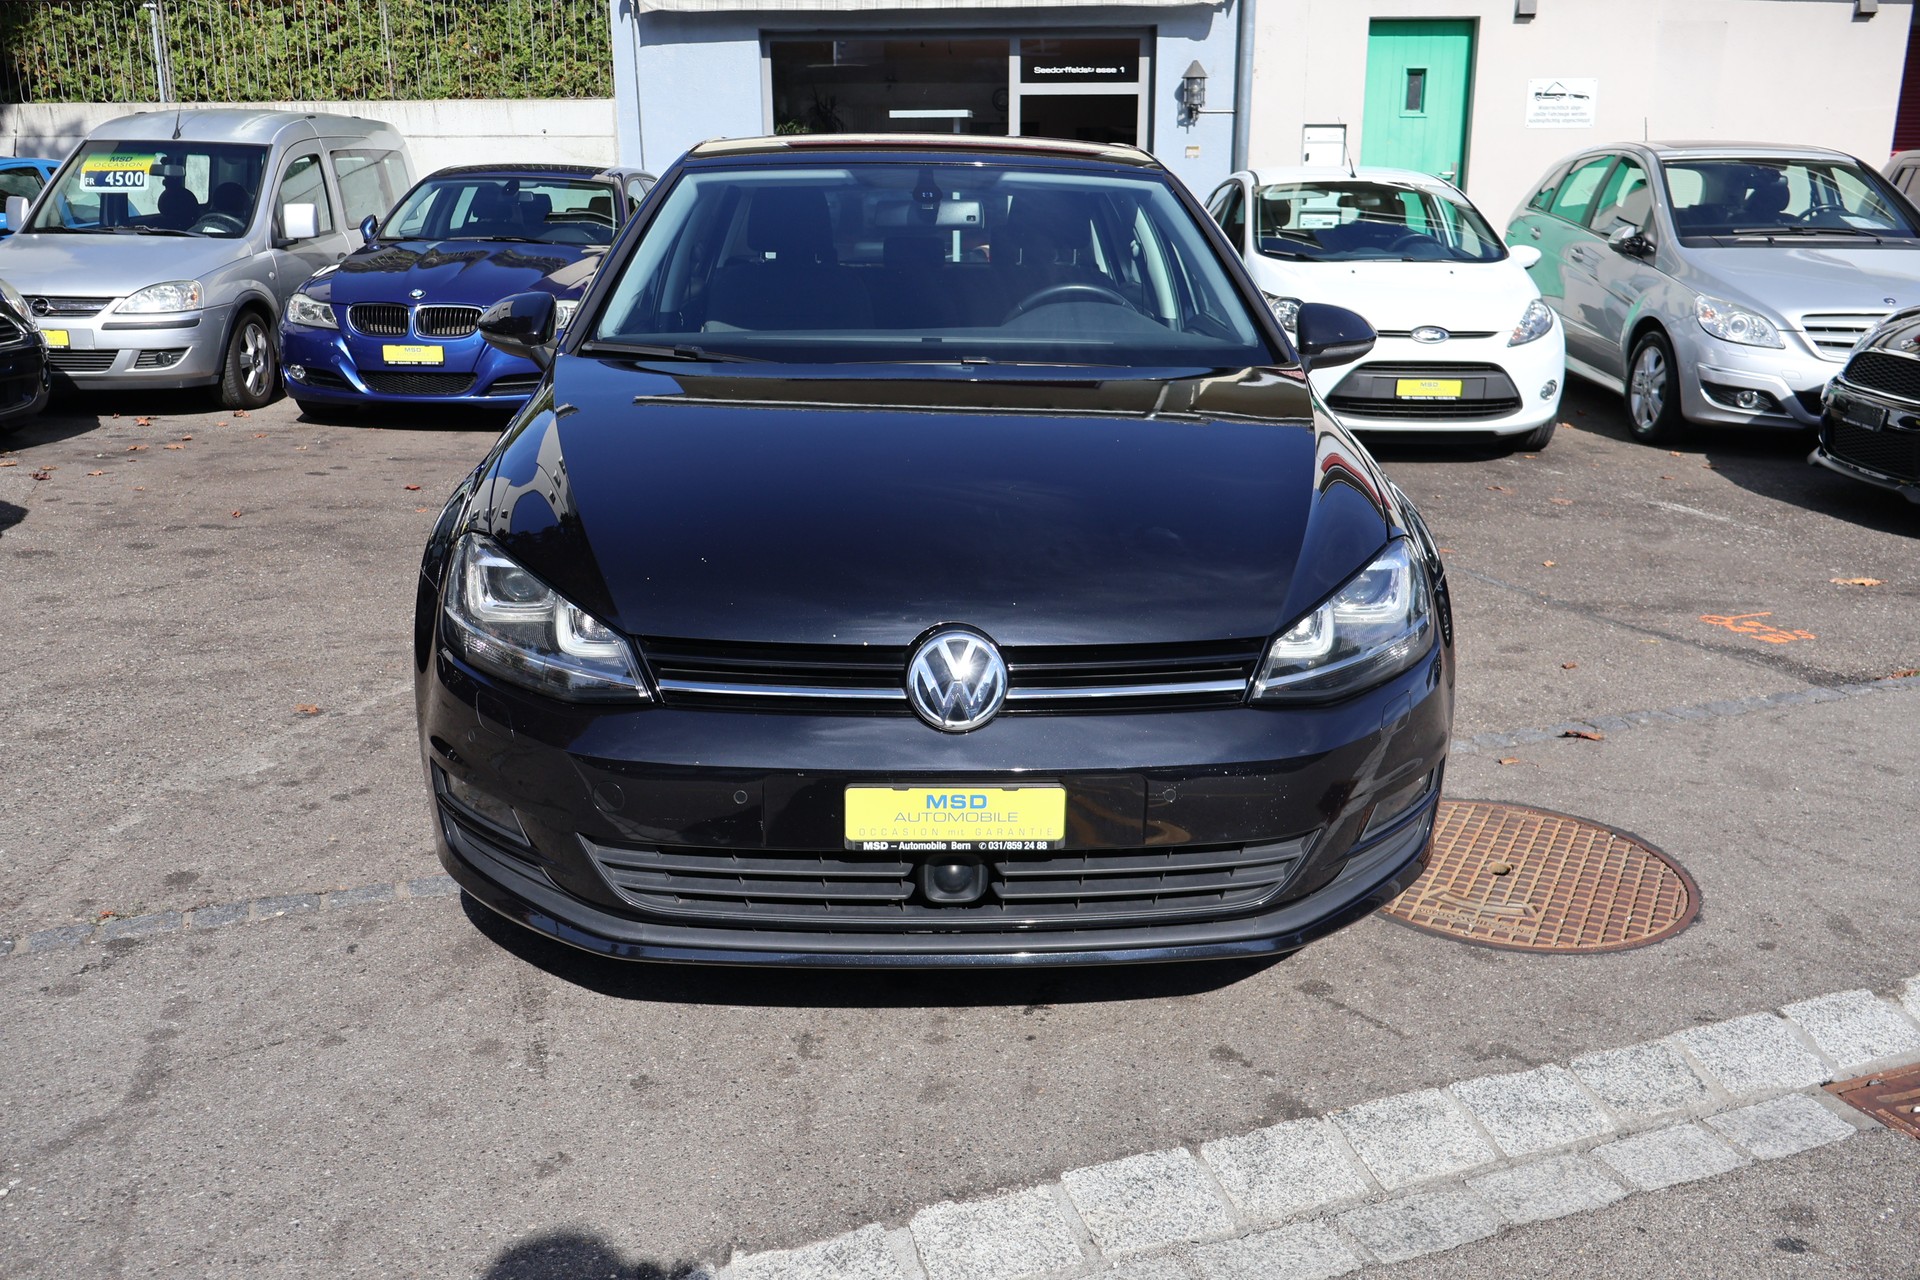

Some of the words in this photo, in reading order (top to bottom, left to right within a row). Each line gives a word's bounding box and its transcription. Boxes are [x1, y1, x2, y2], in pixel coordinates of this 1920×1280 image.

[105, 171, 144, 186] 4500
[926, 794, 987, 809] MSD
[894, 812, 1018, 822] AUTOMOBILE
[859, 828, 938, 837] OCCASION
[975, 828, 1053, 836] GARANTIE
[863, 841, 889, 850] MSD
[899, 841, 947, 850] Automobile
[951, 841, 971, 850] Bern
[988, 841, 1022, 850] 031/859
[1024, 841, 1035, 850] 24
[1036, 841, 1047, 850] 88
